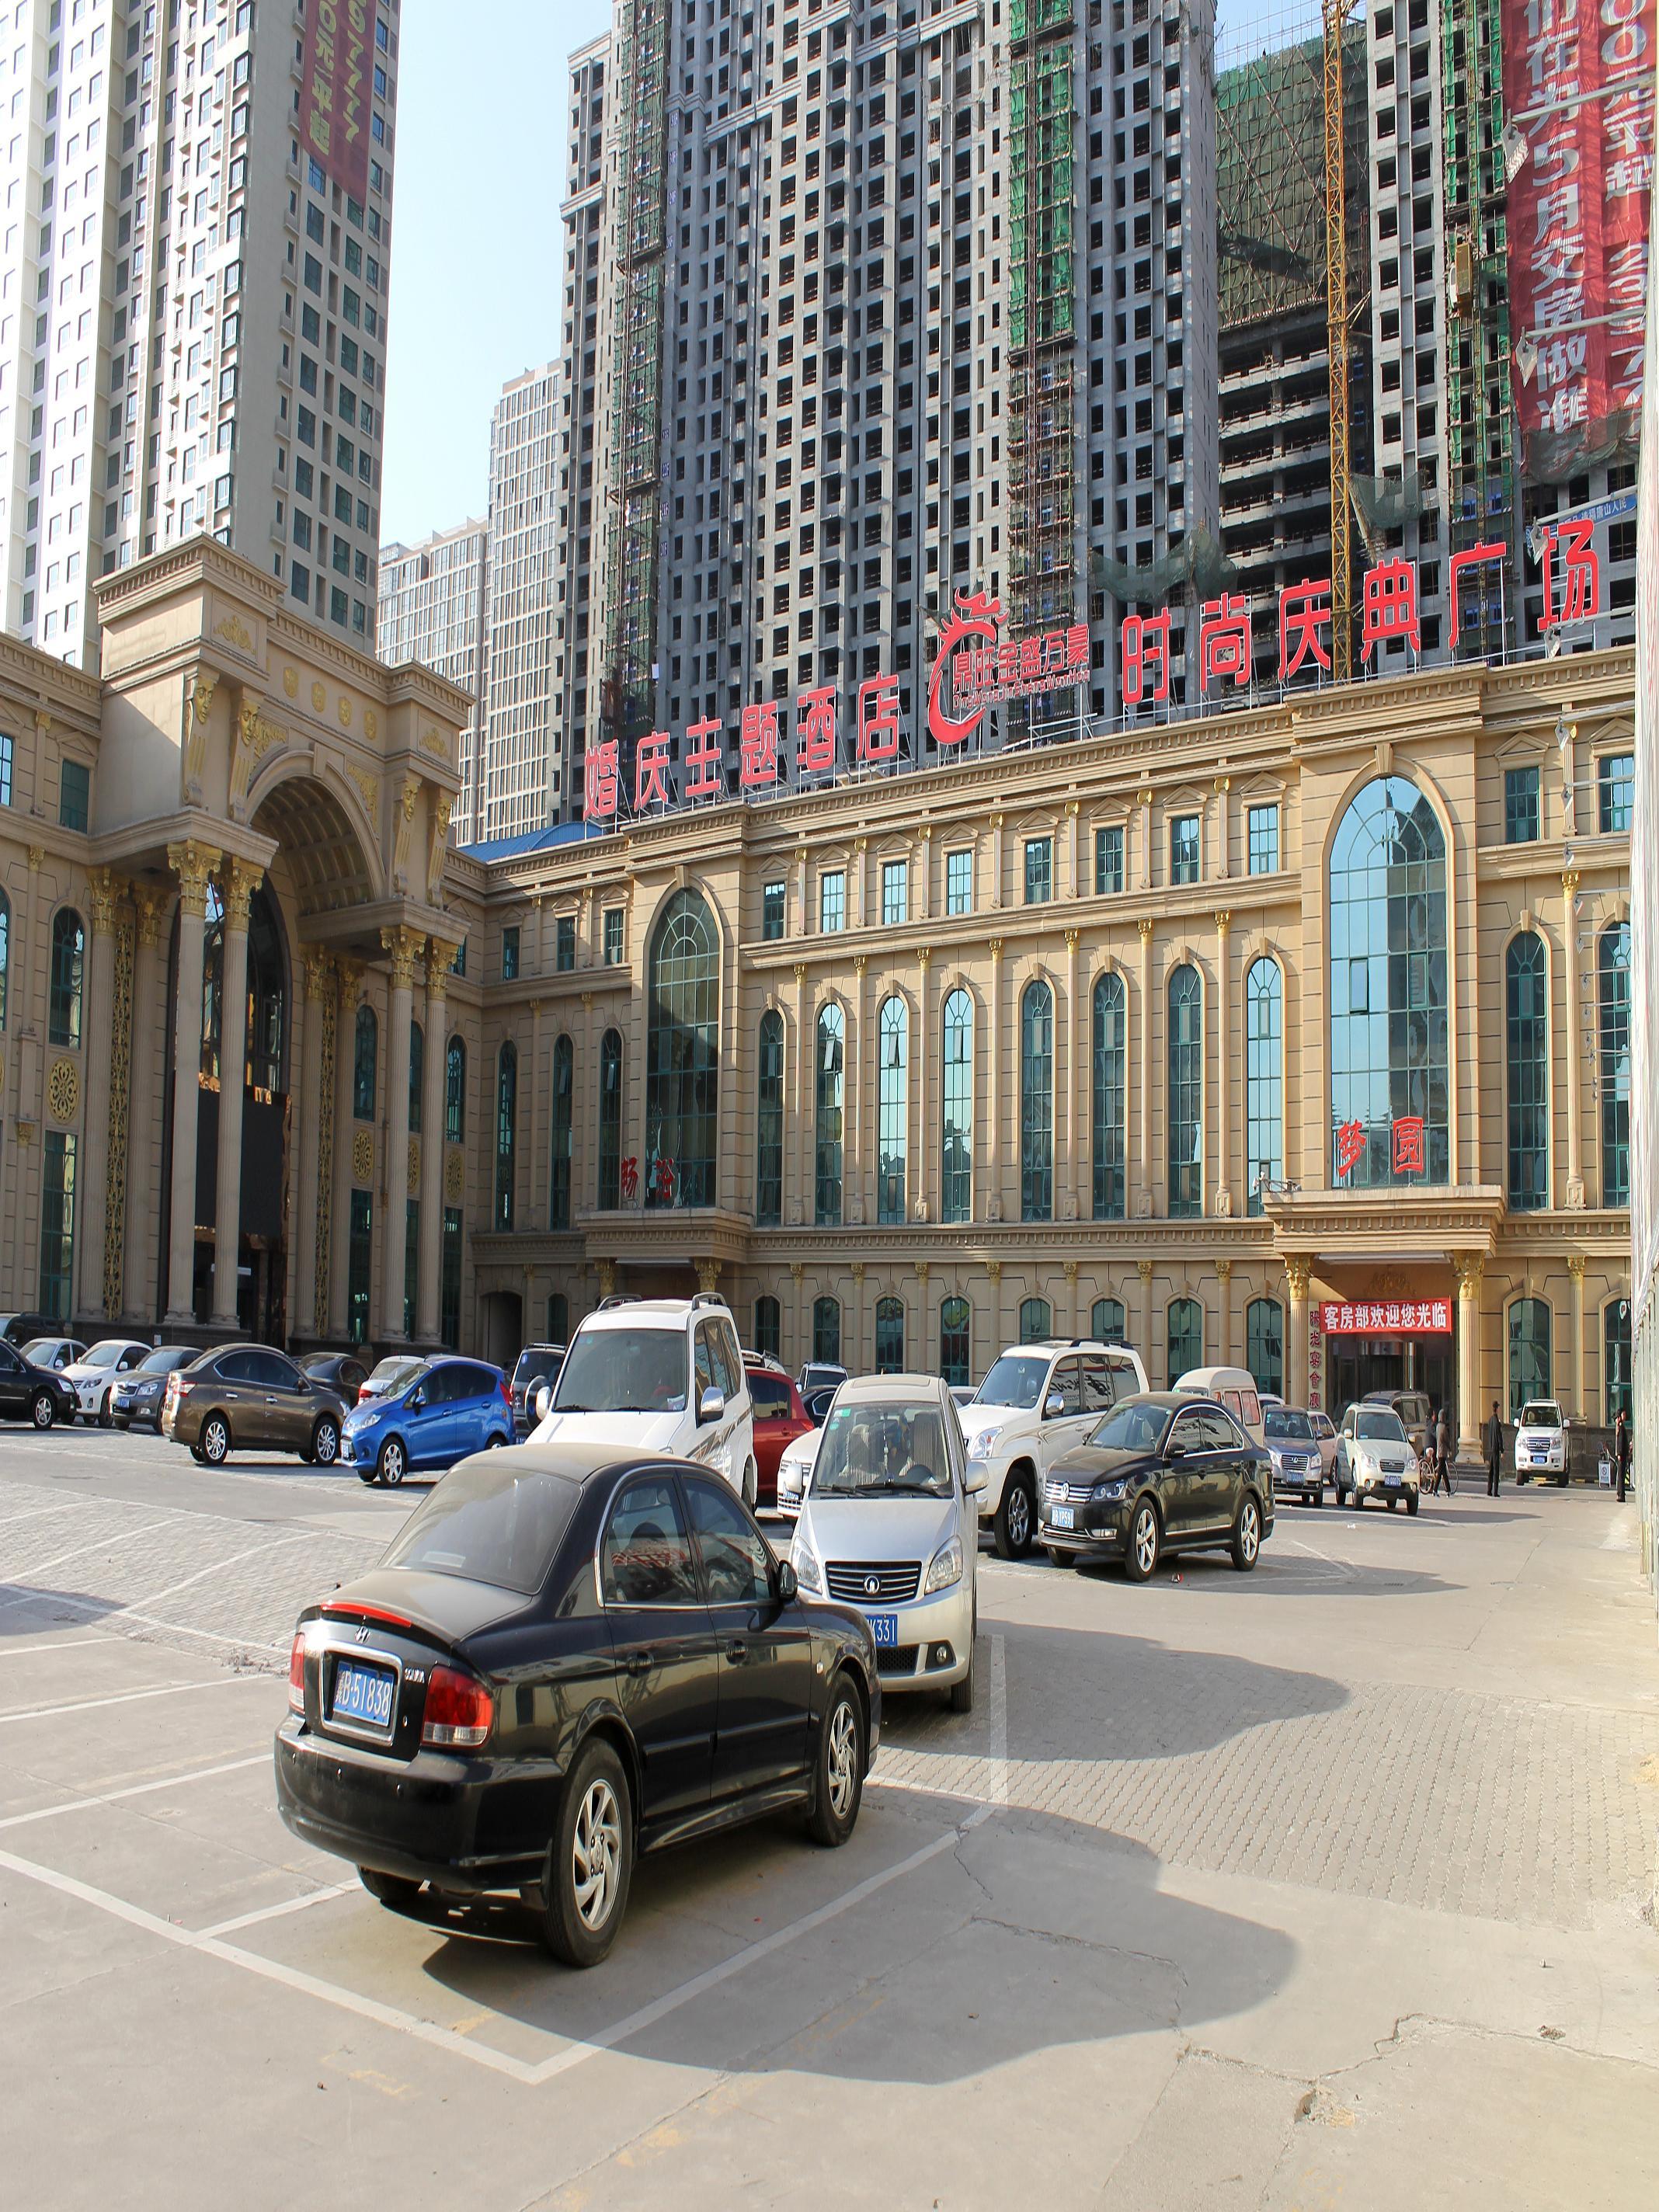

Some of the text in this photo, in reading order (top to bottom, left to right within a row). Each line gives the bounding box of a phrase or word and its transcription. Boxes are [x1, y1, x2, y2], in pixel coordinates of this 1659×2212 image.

[343, 0, 367, 144] 97777
[1122, 519, 1600, 704] 时尚庆典广场
[953, 624, 1089, 693] 鼎旺金盛万豪
[583, 671, 899, 821] 婚庆主题酒店
[1337, 1116, 1424, 1177] 梦圆
[1324, 1303, 1447, 1330] 客房部欢迎您光临
[868, 1619, 895, 1643] K331
